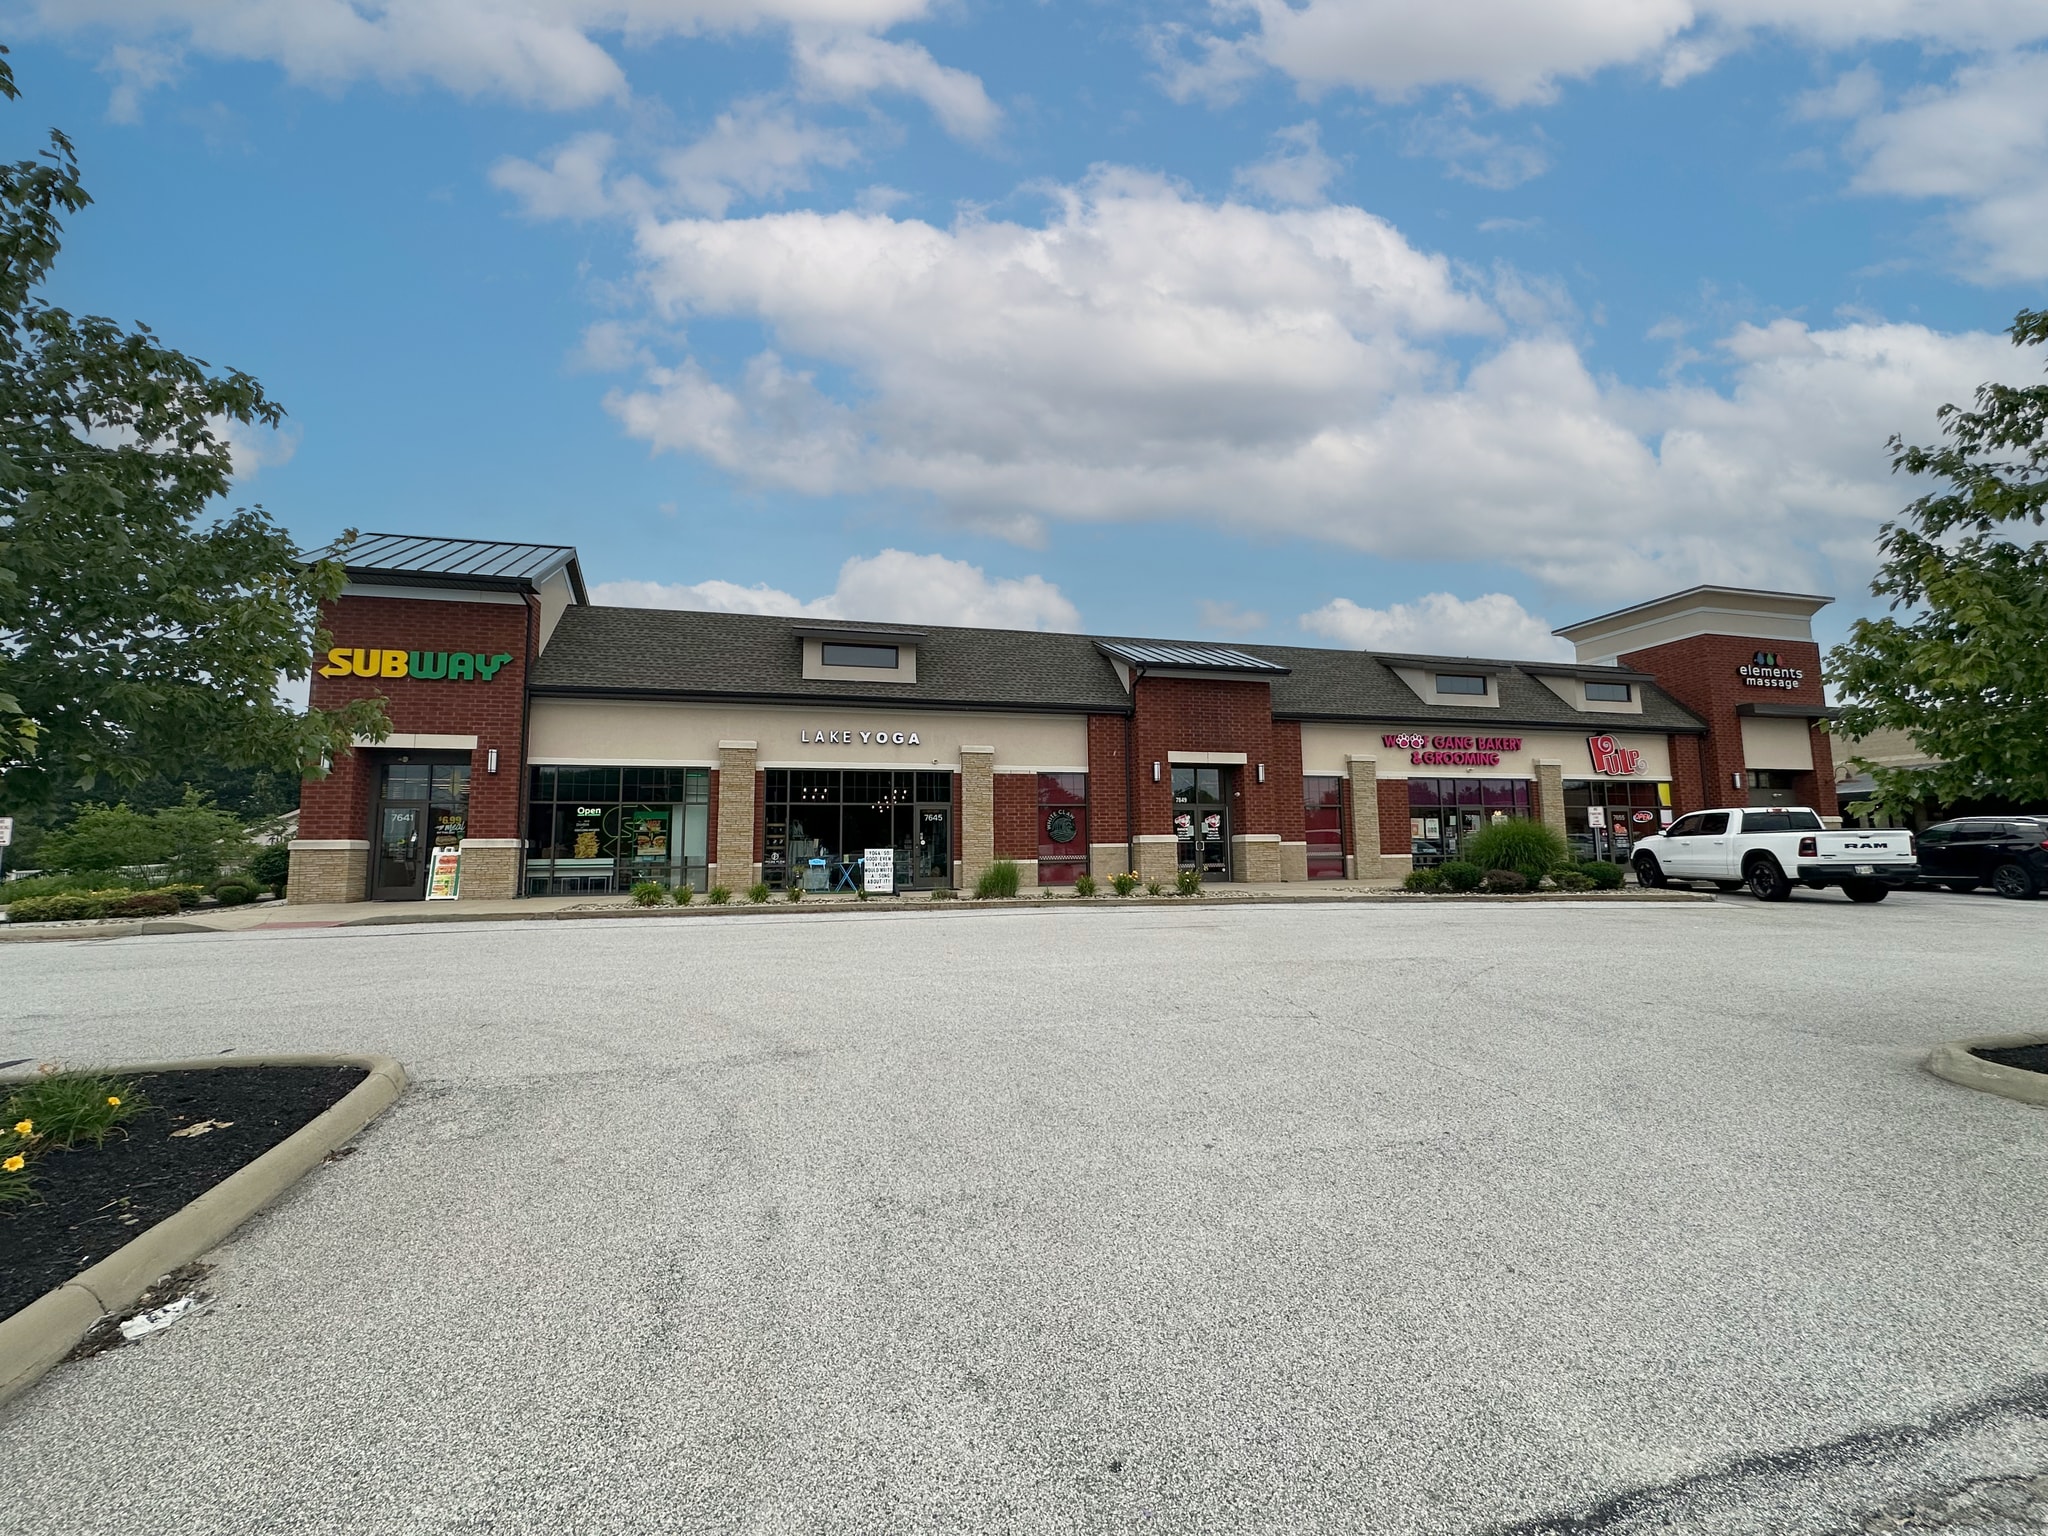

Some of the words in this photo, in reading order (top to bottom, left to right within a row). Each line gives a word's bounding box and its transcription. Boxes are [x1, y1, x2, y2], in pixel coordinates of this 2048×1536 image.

[317, 648, 514, 680] SUBWAY
[1739, 664, 1803, 678] elements
[1746, 677, 1799, 690] massage
[801, 730, 851, 743] LAKE
[860, 731, 920, 744] YOGA
[1432, 735, 1475, 749] GANG
[1476, 737, 1523, 751] BAKERY
[577, 806, 602, 816] Open
[391, 813, 414, 822] 7641
[438, 815, 462, 825] $6.99
[923, 813, 943, 822] 7645
[1634, 813, 1651, 821] OPEN
